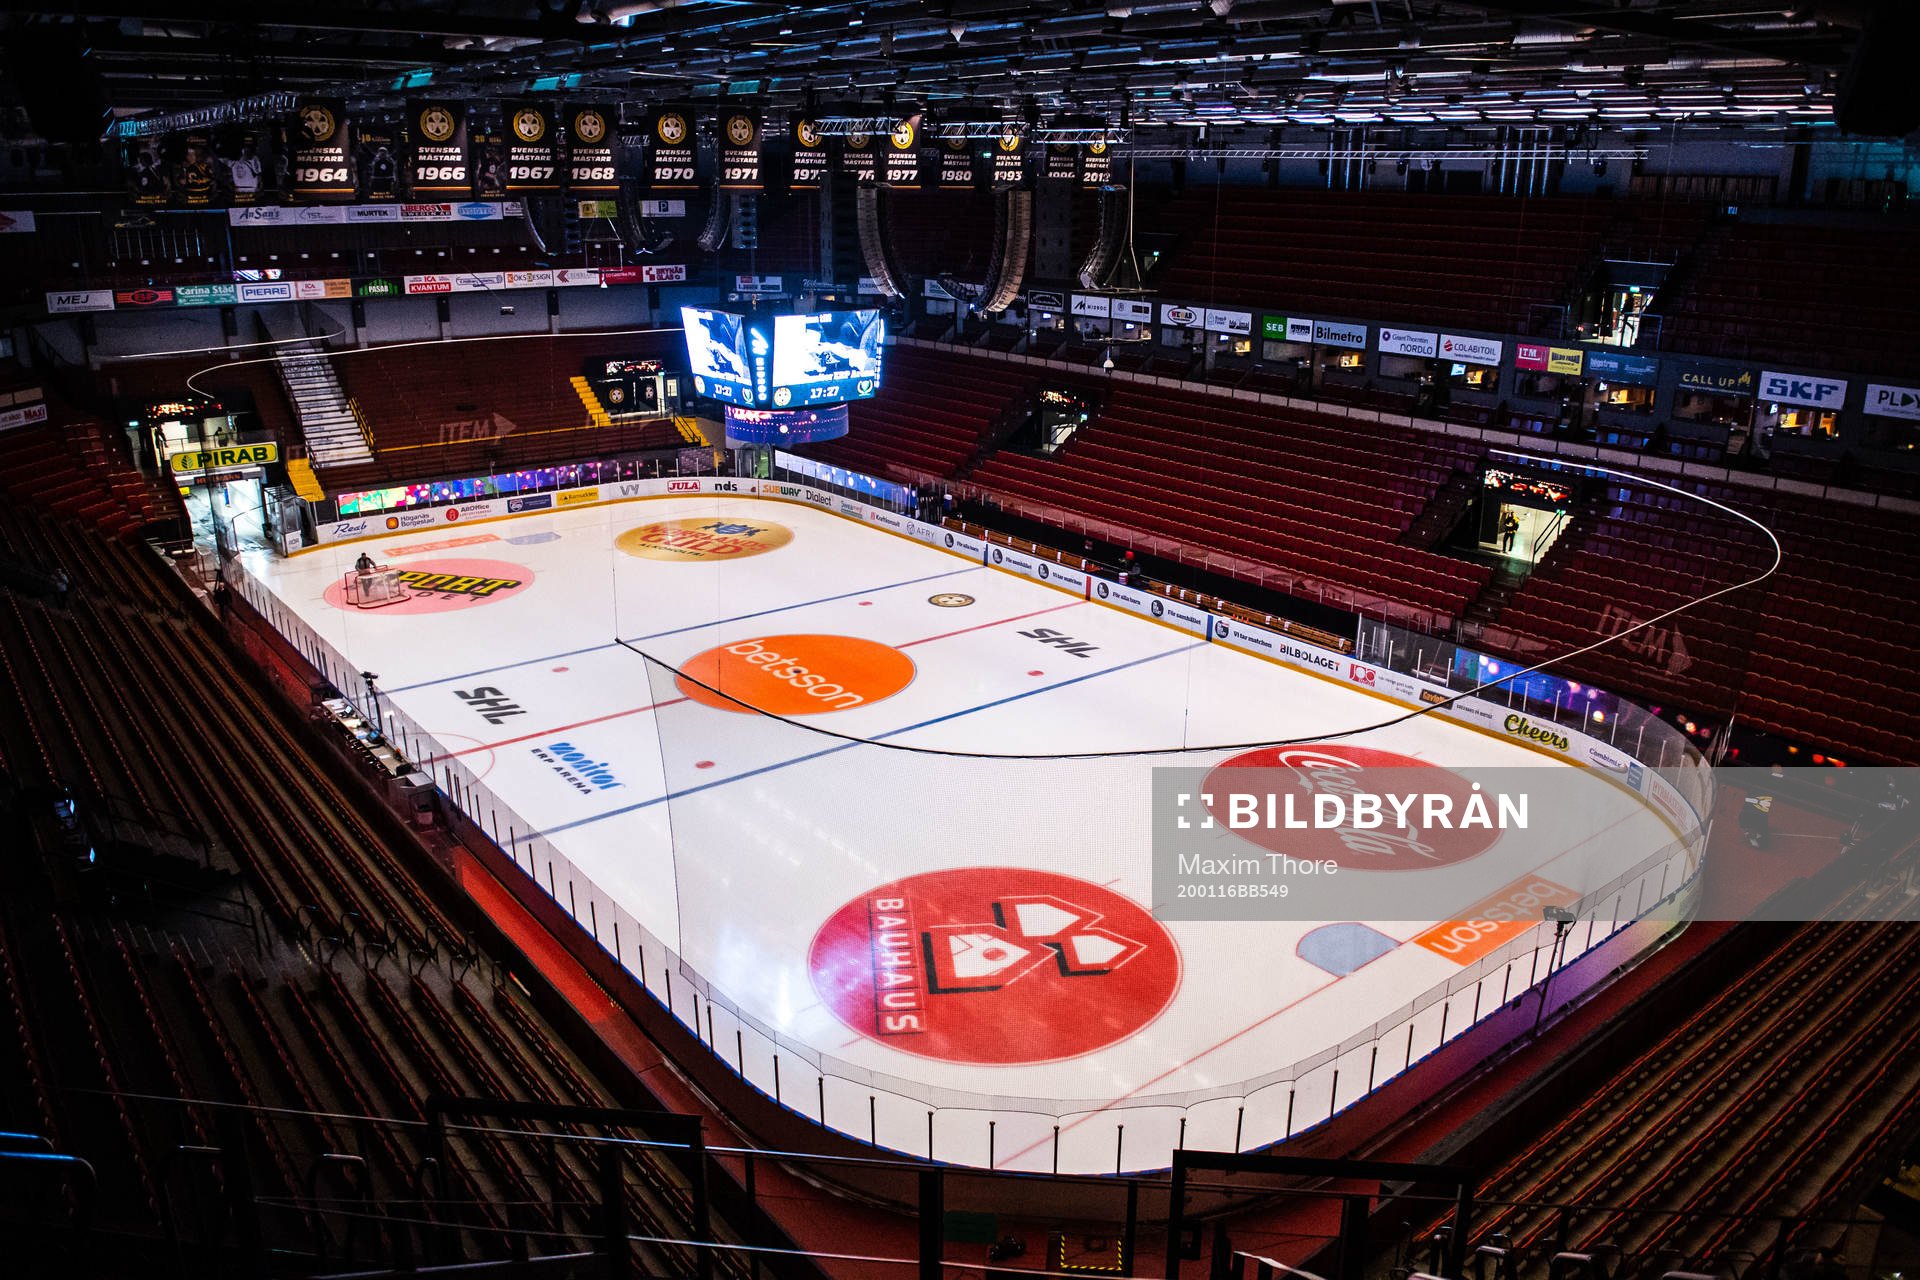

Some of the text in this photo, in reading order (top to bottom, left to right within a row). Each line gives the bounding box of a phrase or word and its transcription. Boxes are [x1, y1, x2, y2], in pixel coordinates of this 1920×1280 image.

[295, 168, 348, 182] 1964
[416, 167, 466, 180] 1966
[509, 167, 554, 180] 1967
[571, 167, 615, 180] 1968
[654, 167, 694, 180] 1970
[724, 167, 759, 180] 1971
[793, 168, 825, 181] 197
[887, 169, 918, 181] 1977
[941, 170, 972, 181] 1980
[401, 204, 436, 212] LIBERGS
[178, 287, 210, 297] Carina
[244, 287, 287, 297] PIERRE
[411, 283, 450, 291] KVANTUM
[57, 295, 89, 305] MEJ
[1265, 322, 1284, 332] SEB
[1316, 326, 1363, 343] Bilmetro
[1454, 343, 1497, 356] COLABITOIL
[1682, 373, 1736, 388] CALL UP
[810, 386, 840, 399] 17:27
[1766, 377, 1839, 401] SKF
[196, 447, 268, 467] PIRAB
[669, 482, 699, 491] JULA
[714, 480, 738, 492] nds
[762, 484, 801, 497] SUBWAY
[806, 490, 832, 506] Dialect
[401, 518, 435, 528] Borgestad
[916, 528, 935, 539] AFRY
[1167, 608, 1175, 618] För
[1016, 628, 1100, 659] SHL
[1240, 632, 1248, 641] tar
[1248, 635, 1272, 649] matchen
[1279, 642, 1342, 672] BILBOLAGET
[725, 639, 864, 709] betsson
[453, 686, 527, 725] SHL
[1503, 713, 1570, 752] Cheers
[531, 748, 592, 795] ERP ARENA
[1430, 881, 1559, 955] betsson
[875, 897, 920, 1032] BAUHAUS
